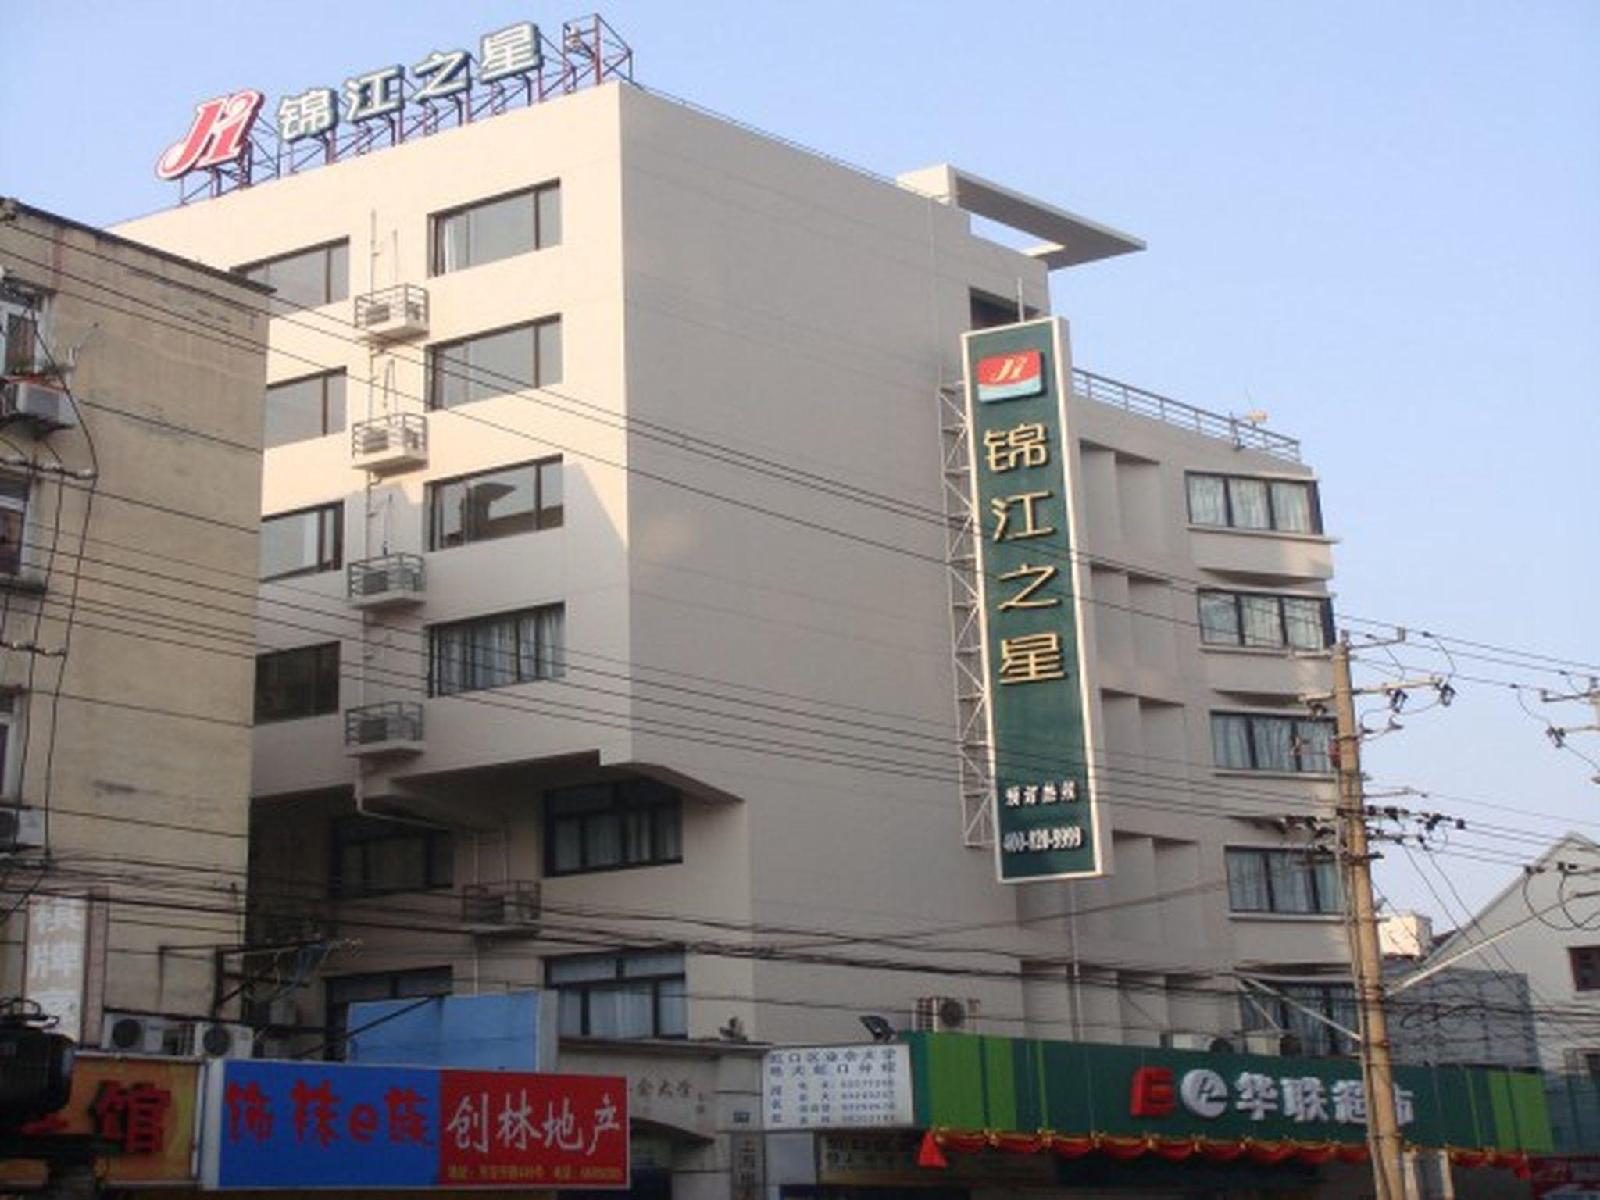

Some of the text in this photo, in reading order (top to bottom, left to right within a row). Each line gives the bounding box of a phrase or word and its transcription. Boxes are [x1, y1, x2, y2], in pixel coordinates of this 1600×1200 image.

[278, 21, 539, 143] 锦江之星
[983, 421, 1066, 685] 锦江之星
[447, 1088, 621, 1156] 创林地产
